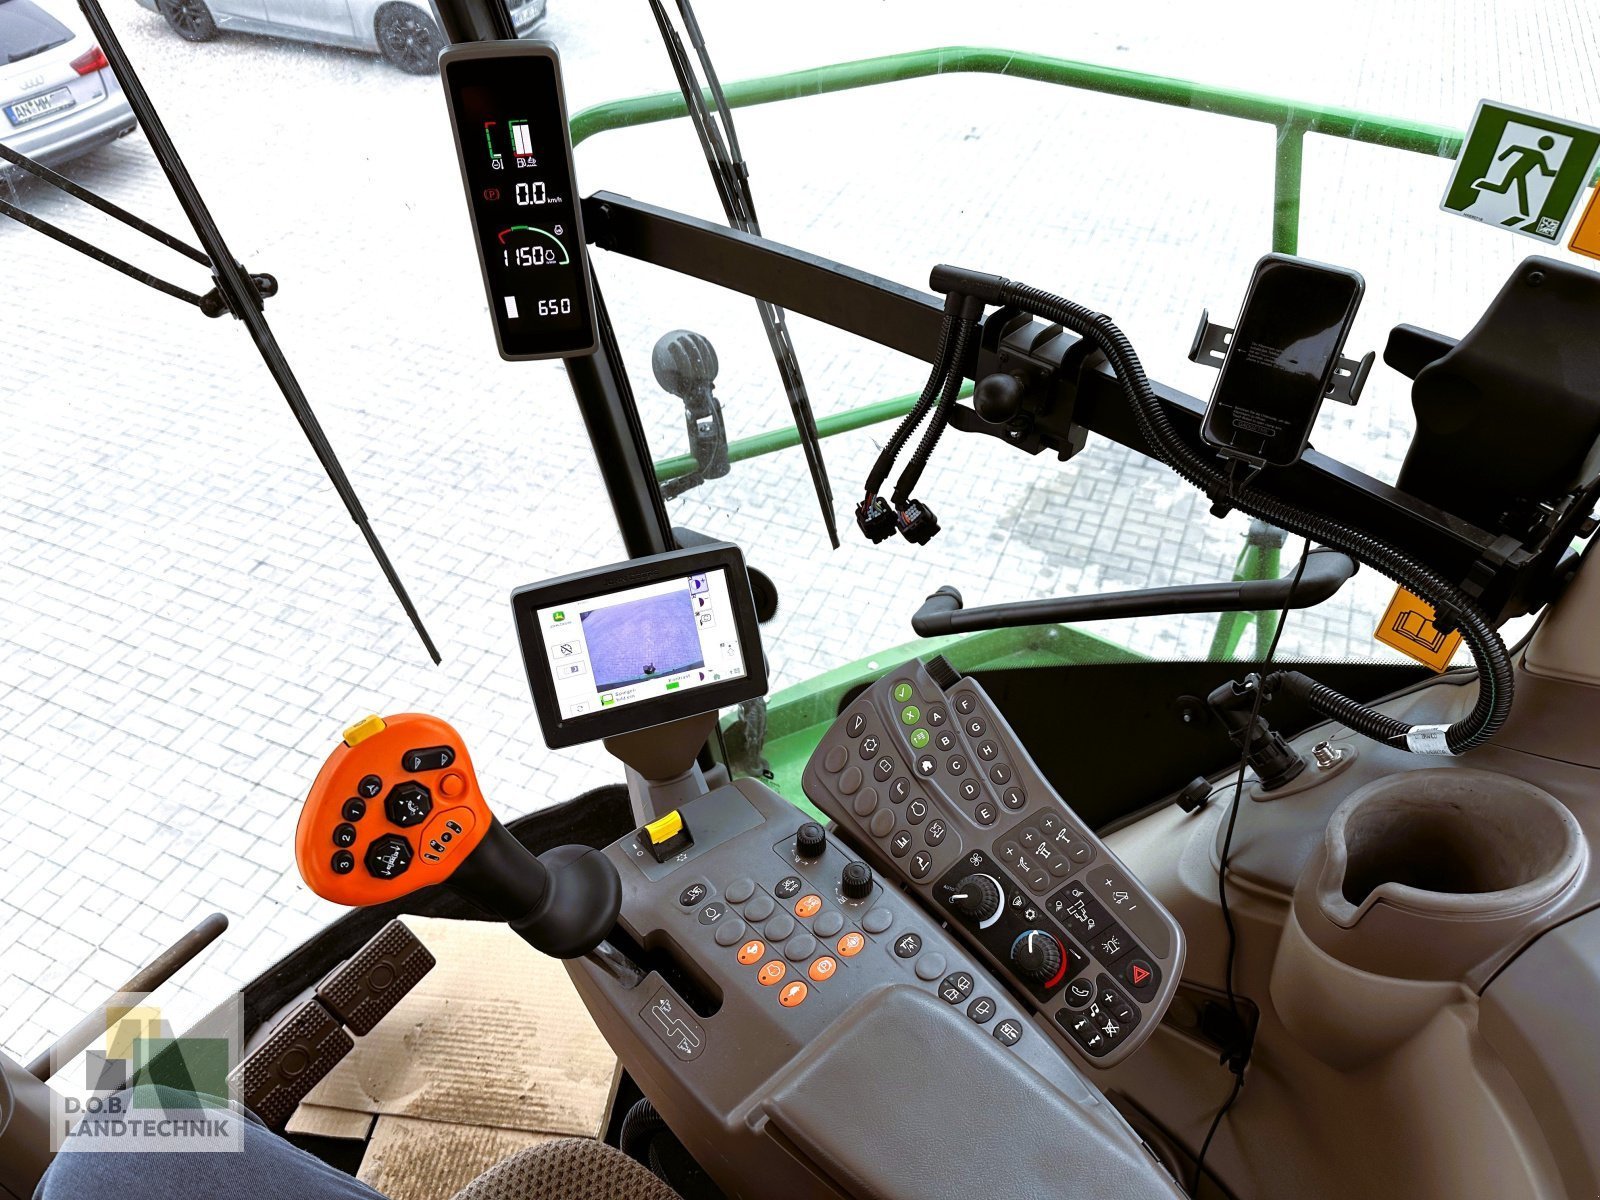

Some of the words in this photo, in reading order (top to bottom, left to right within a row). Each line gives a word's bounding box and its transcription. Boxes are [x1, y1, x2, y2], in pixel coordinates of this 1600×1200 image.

[515, 181, 546, 206] 0.0
[547, 196, 563, 204] km/h
[503, 245, 544, 267] 1150
[538, 298, 571, 316] 650
[341, 834, 351, 842] 2
